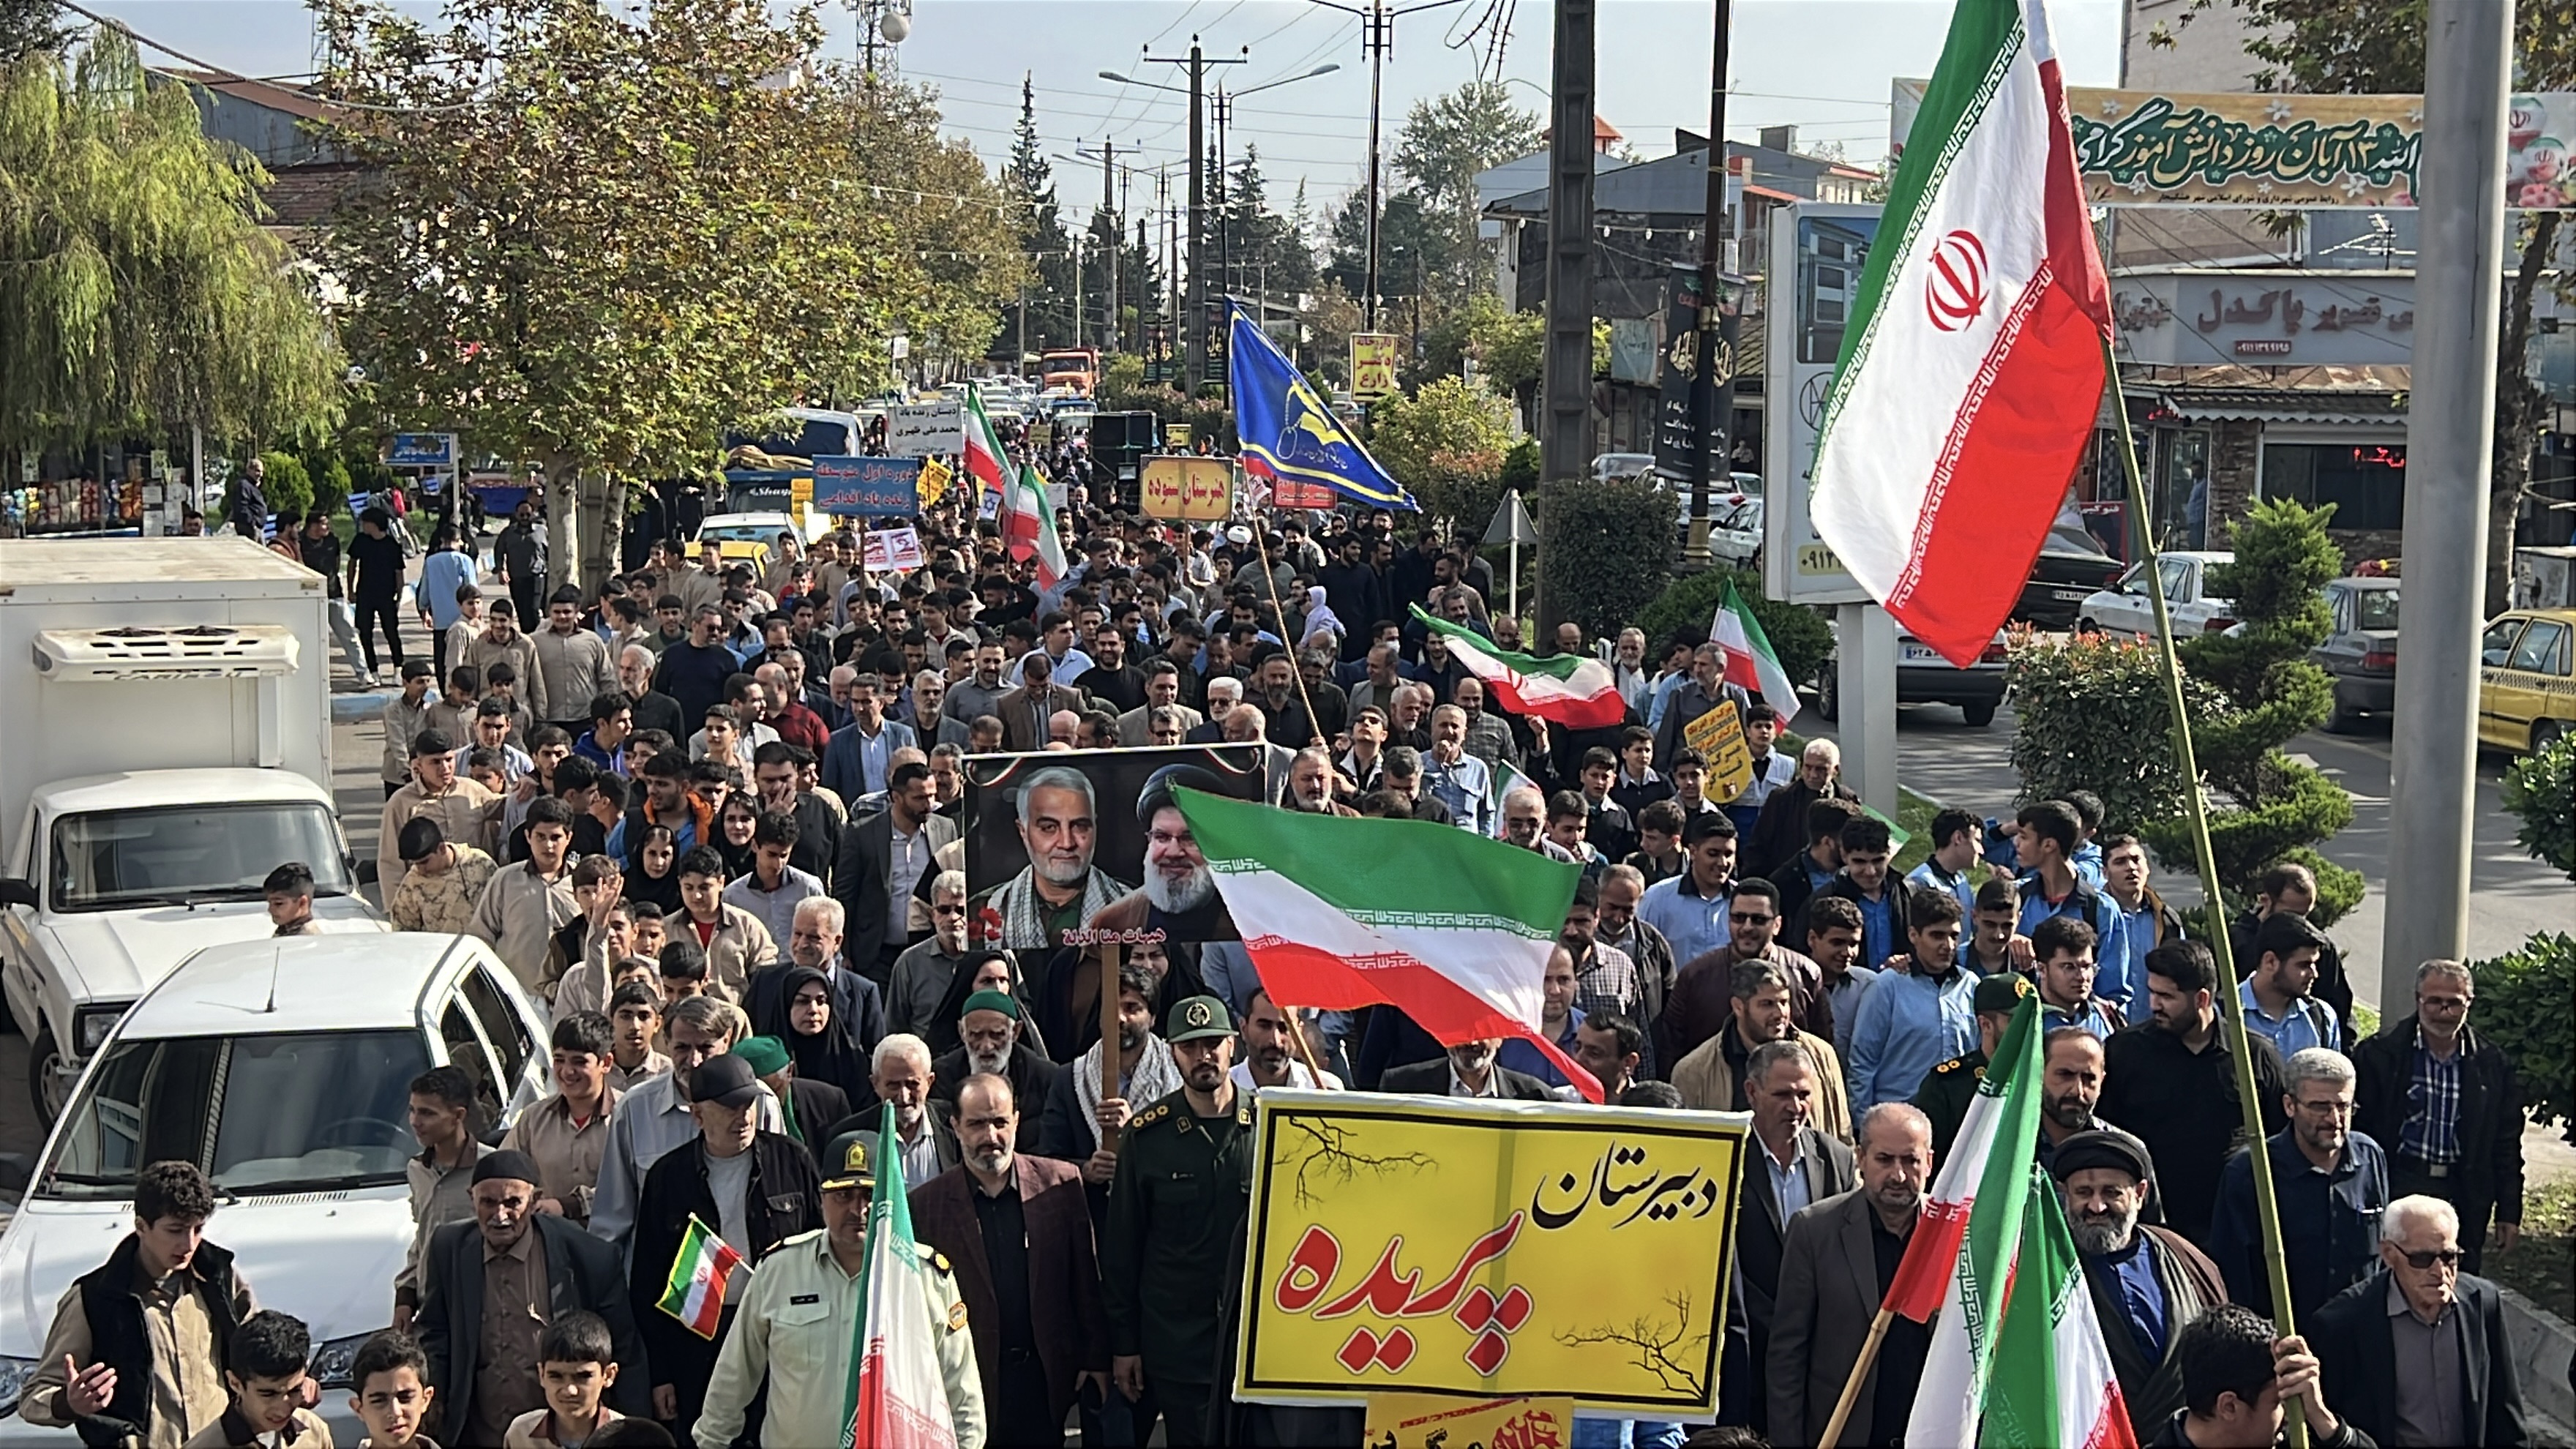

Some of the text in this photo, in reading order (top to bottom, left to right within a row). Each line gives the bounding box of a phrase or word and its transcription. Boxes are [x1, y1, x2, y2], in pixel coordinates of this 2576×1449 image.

[2077, 102, 2168, 170] گرامی
[2277, 121, 2368, 178] آبان
[861, 463, 884, 483] اول
[886, 466, 914, 484] دوره
[1531, 1137, 1718, 1230] دبیرستان
[1273, 1209, 1535, 1377] پریده
